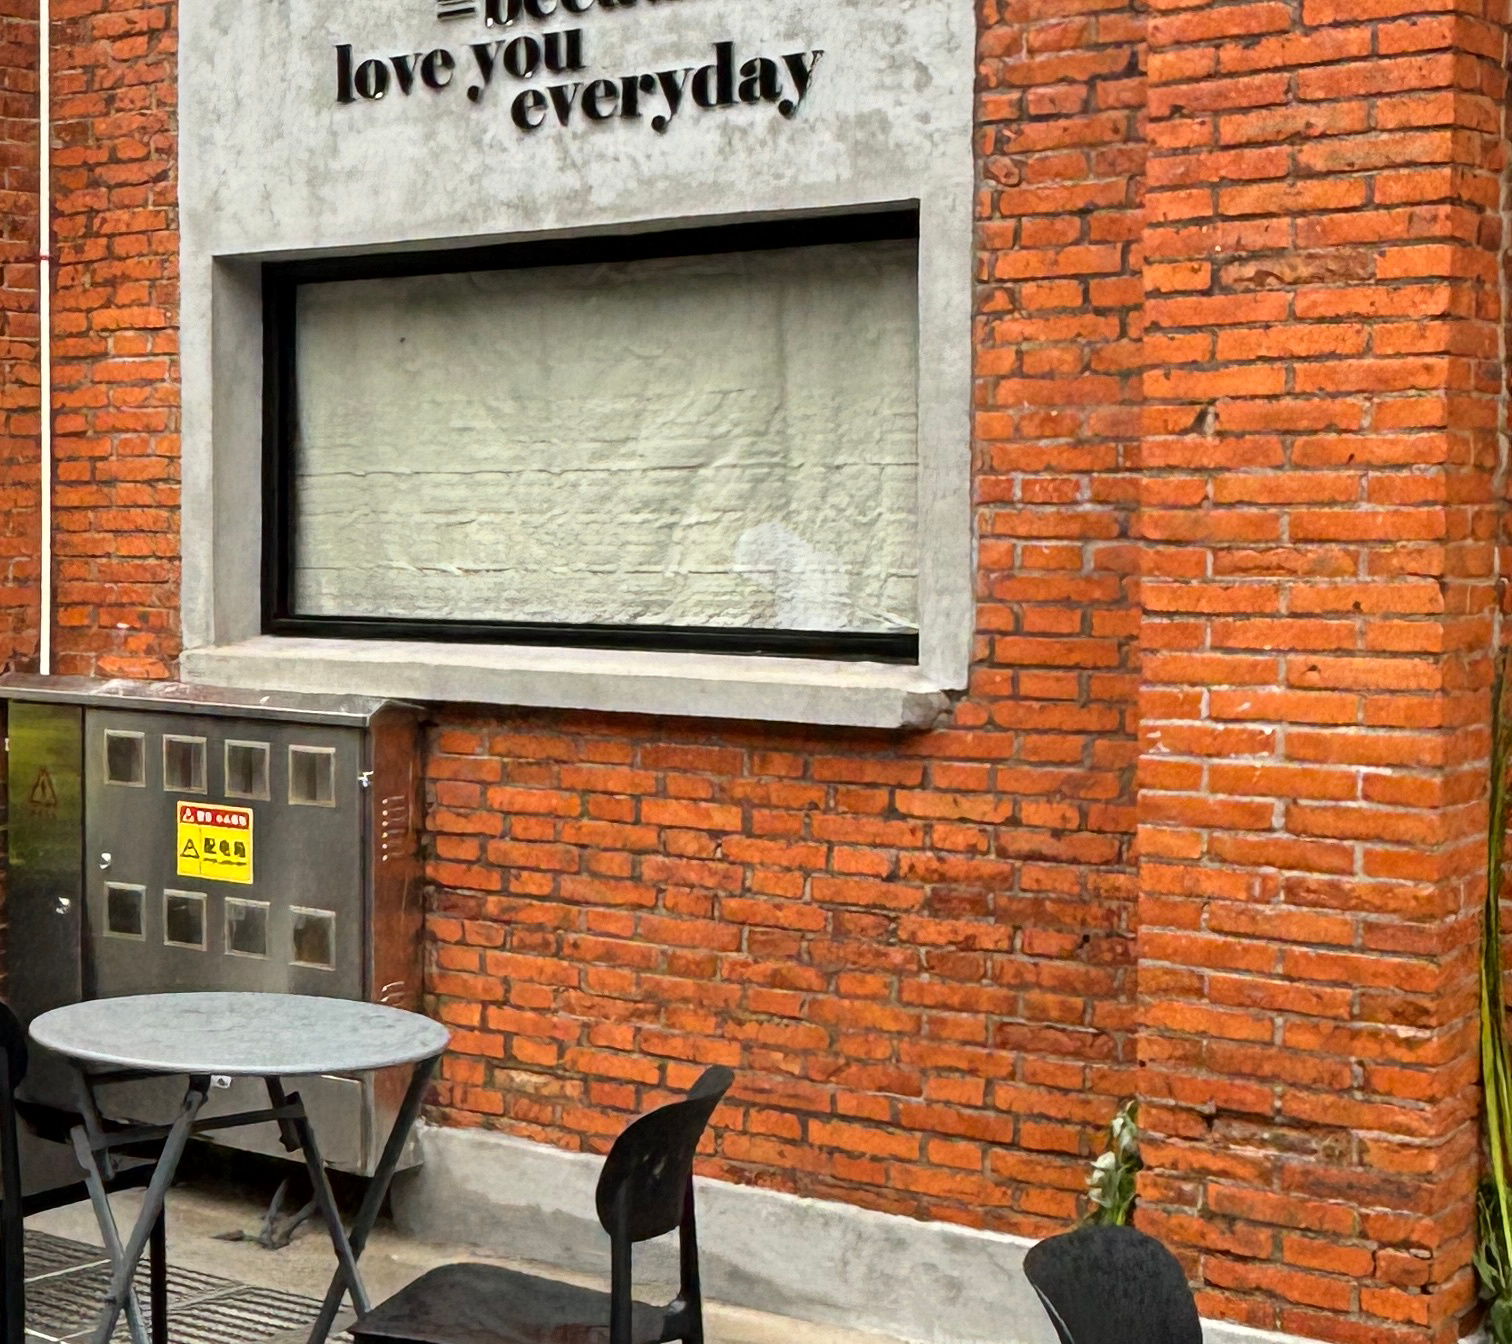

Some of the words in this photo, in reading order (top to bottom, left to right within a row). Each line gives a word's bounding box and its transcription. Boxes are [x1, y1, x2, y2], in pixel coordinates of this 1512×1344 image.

[335, 44, 456, 104] love
[466, 27, 588, 104] you
[510, 40, 826, 135] everyday
